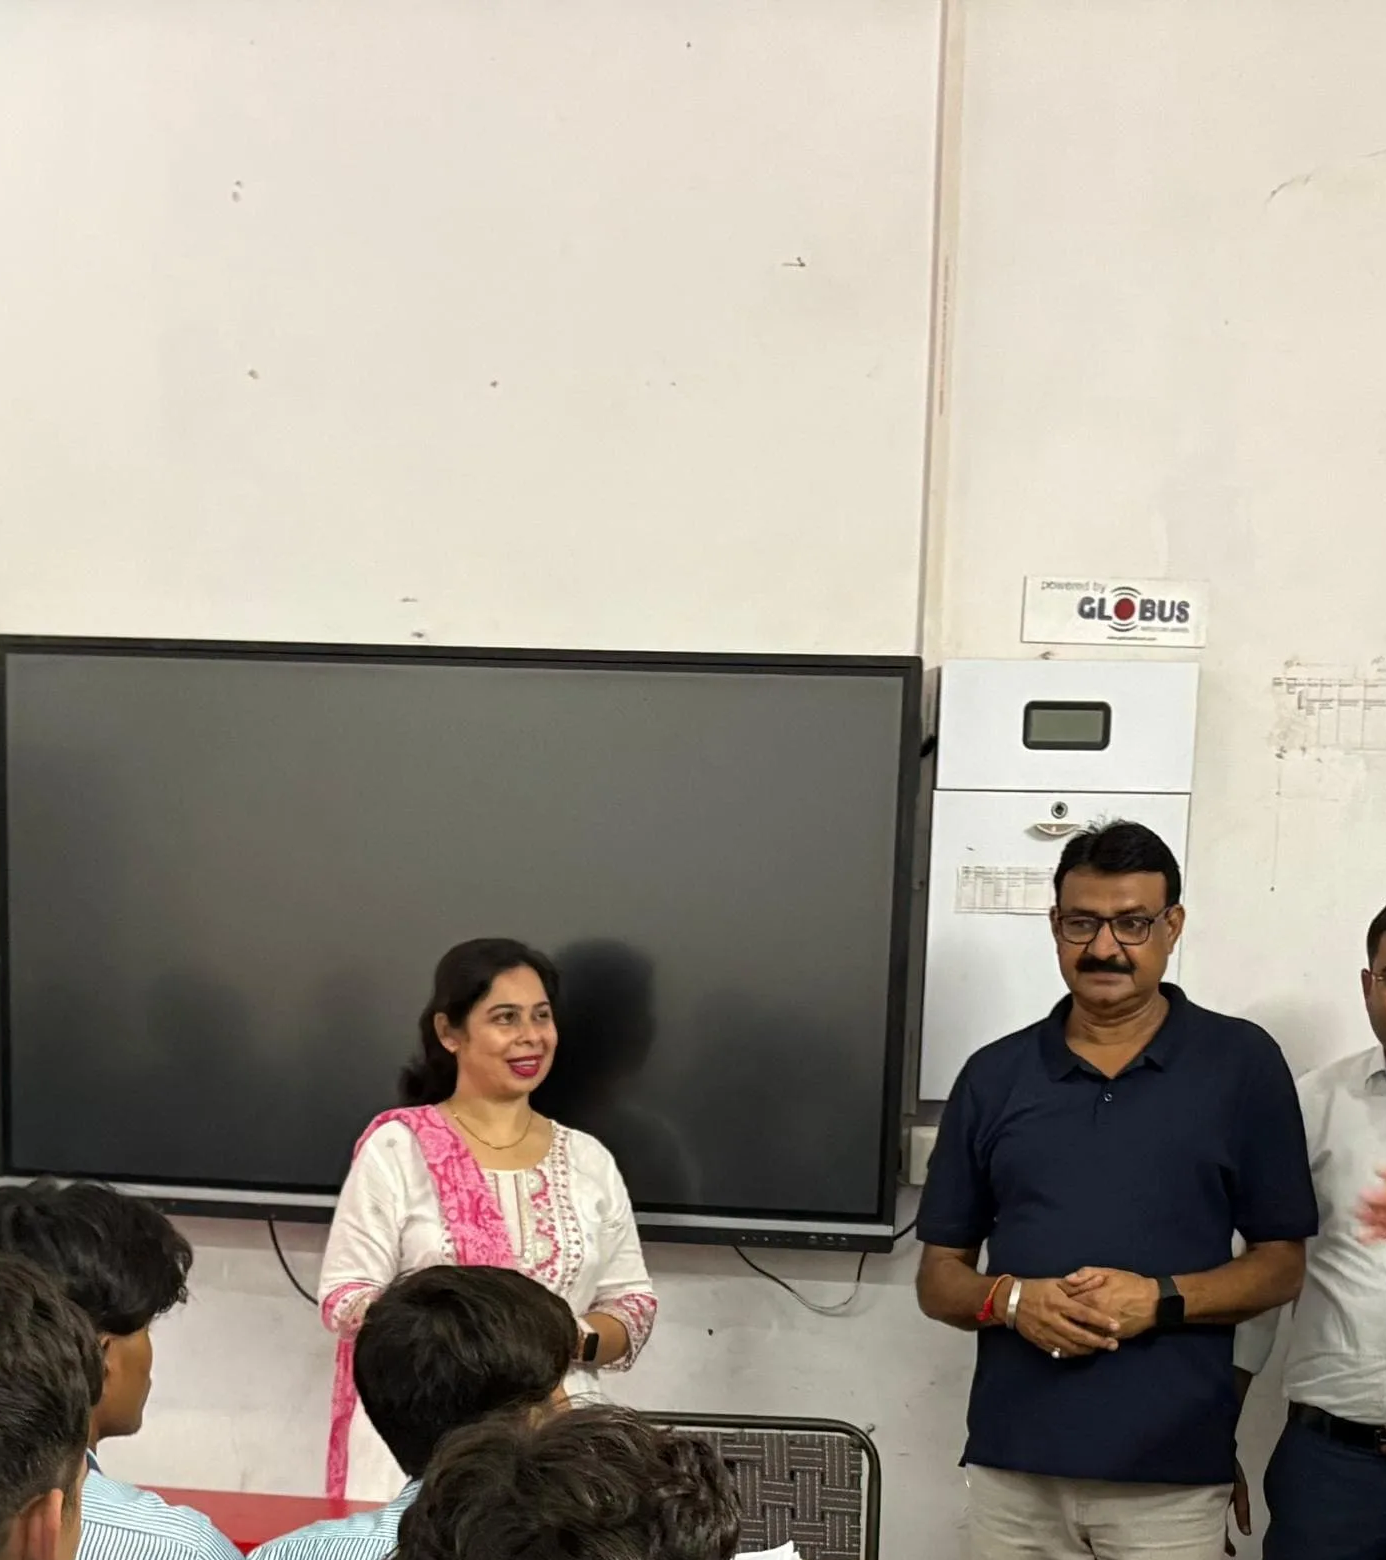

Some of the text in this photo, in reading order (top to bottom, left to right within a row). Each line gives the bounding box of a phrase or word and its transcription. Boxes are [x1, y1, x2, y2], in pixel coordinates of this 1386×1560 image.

[1041, 581, 1107, 594] powered by
[1077, 596, 1190, 623] GLOBUS
